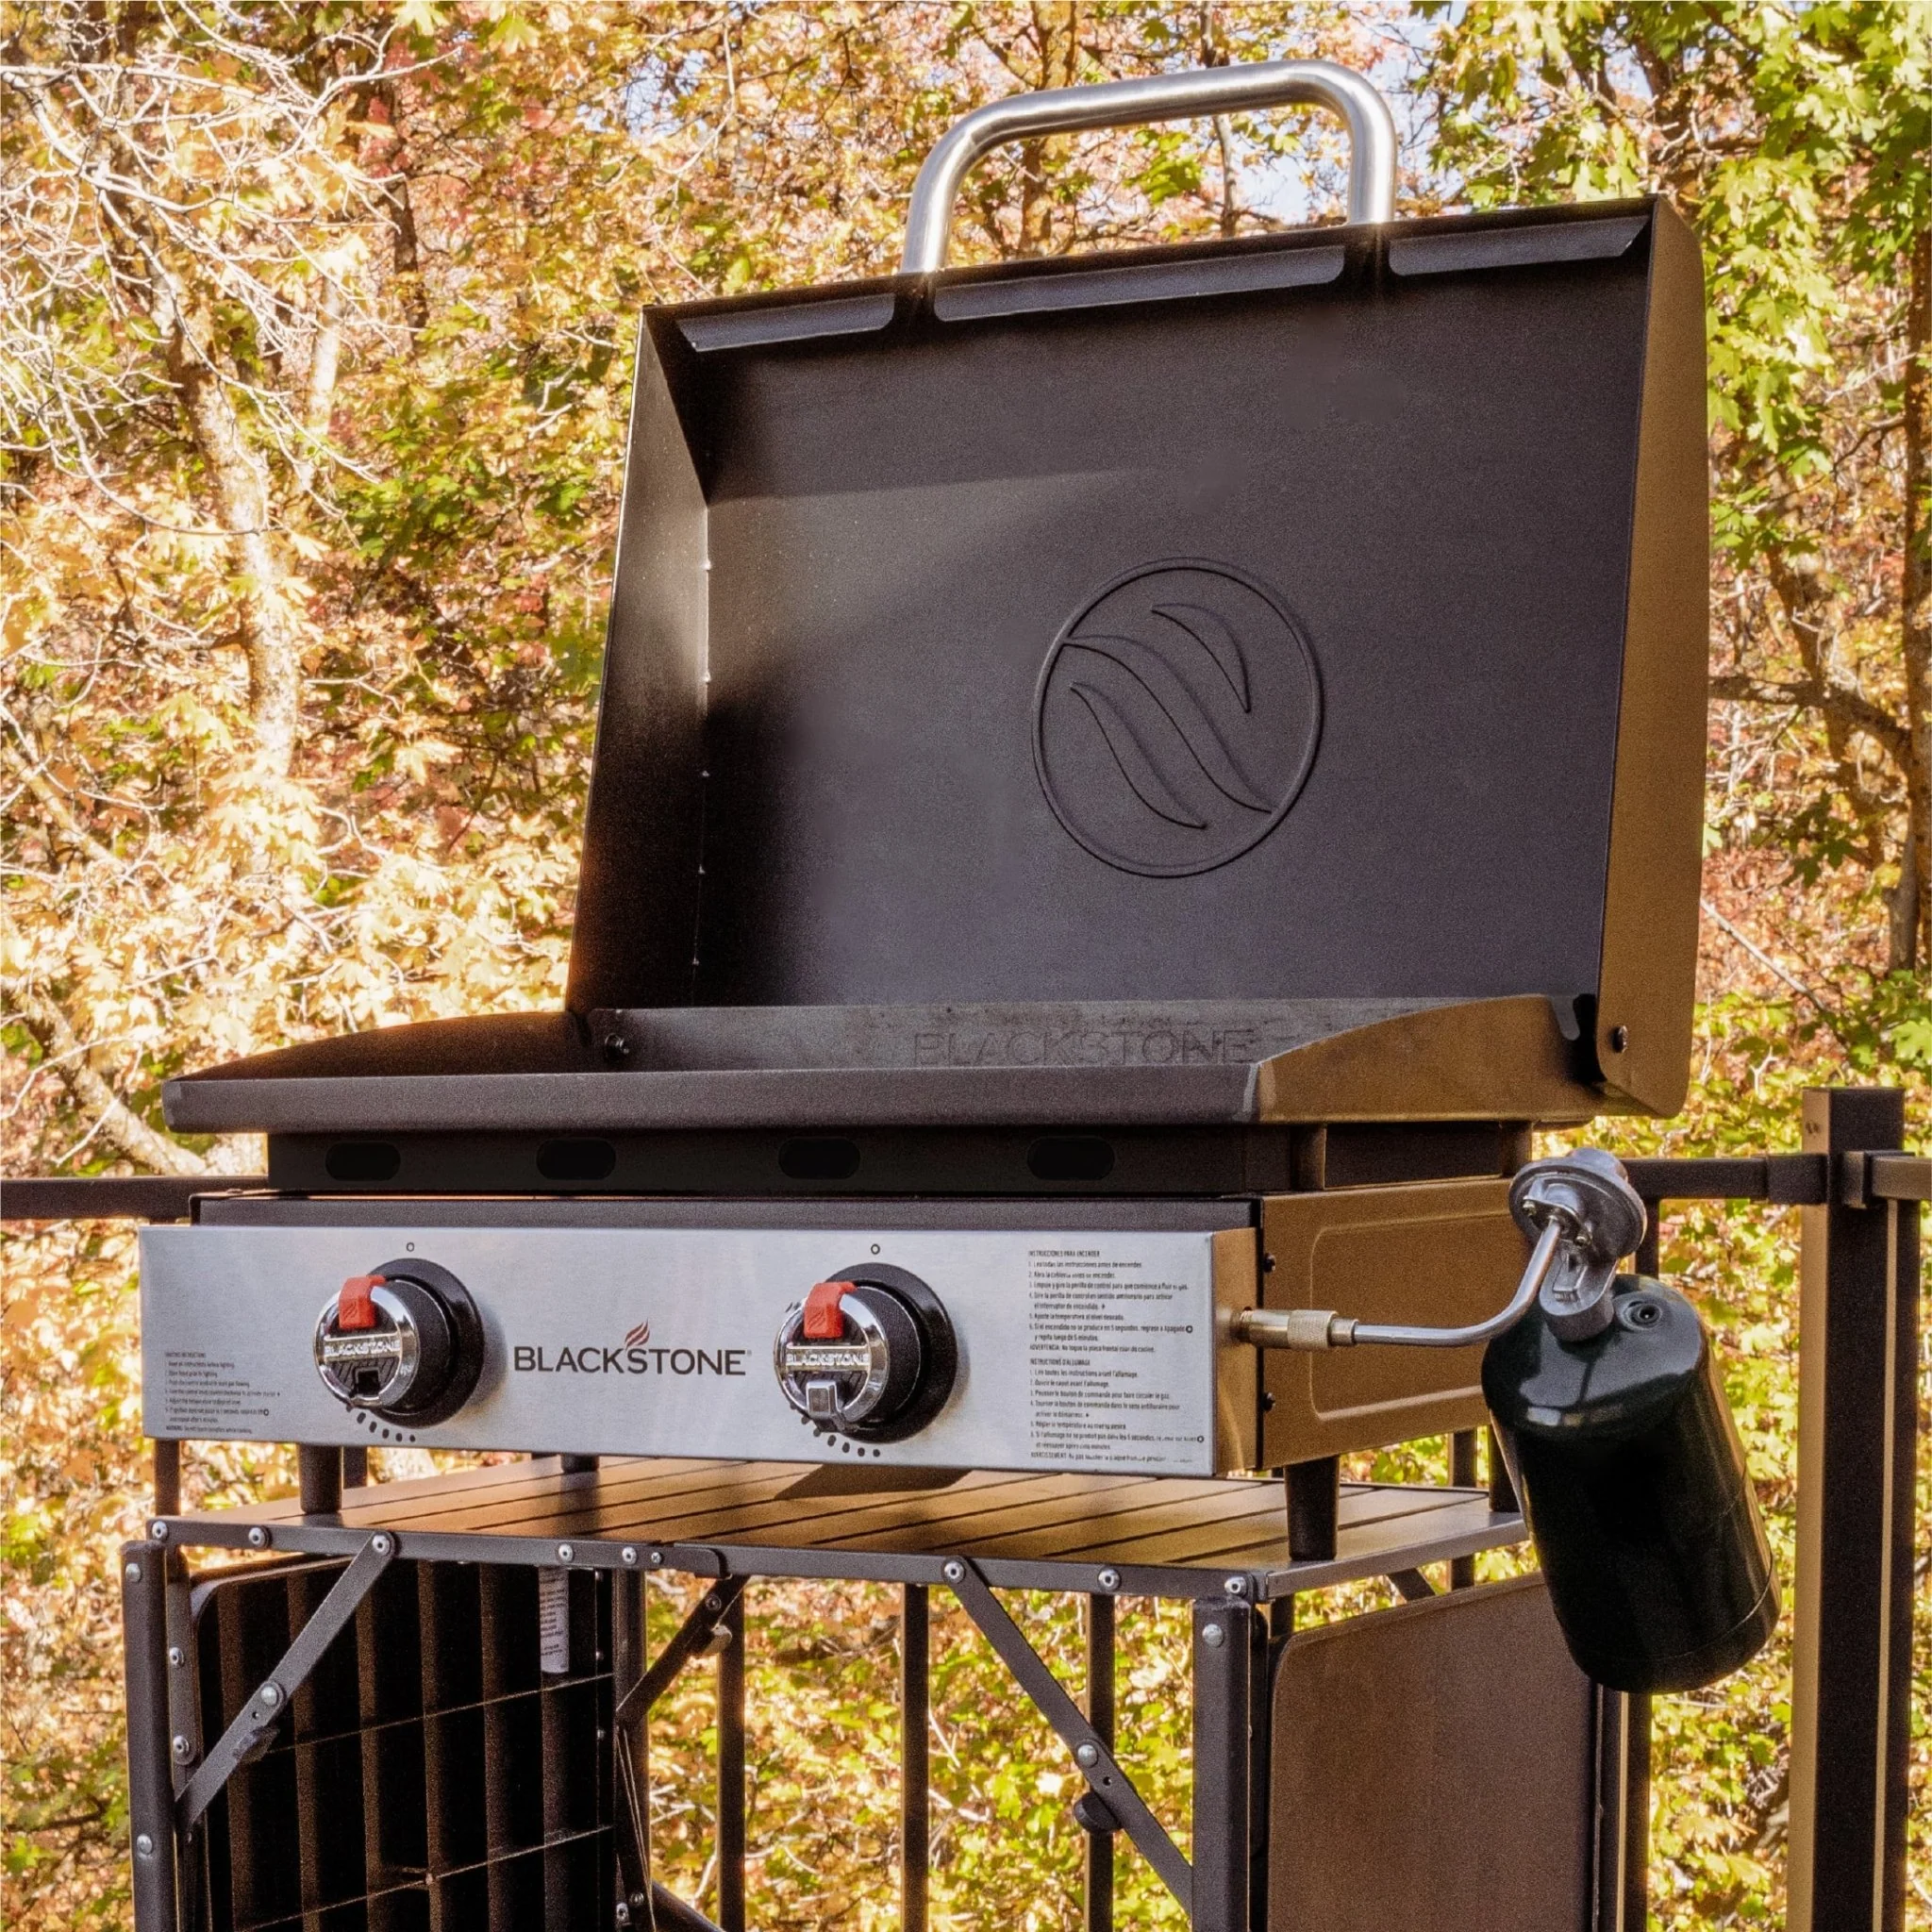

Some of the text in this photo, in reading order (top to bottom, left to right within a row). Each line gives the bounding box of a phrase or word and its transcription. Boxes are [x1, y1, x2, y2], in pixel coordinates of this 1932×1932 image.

[913, 1028, 1255, 1066] BLACKSTONE
[325, 1341, 400, 1357] BLACKSTONE
[513, 1345, 746, 1375] BLACKSTONE
[787, 1353, 870, 1366] BLACKSTONE
